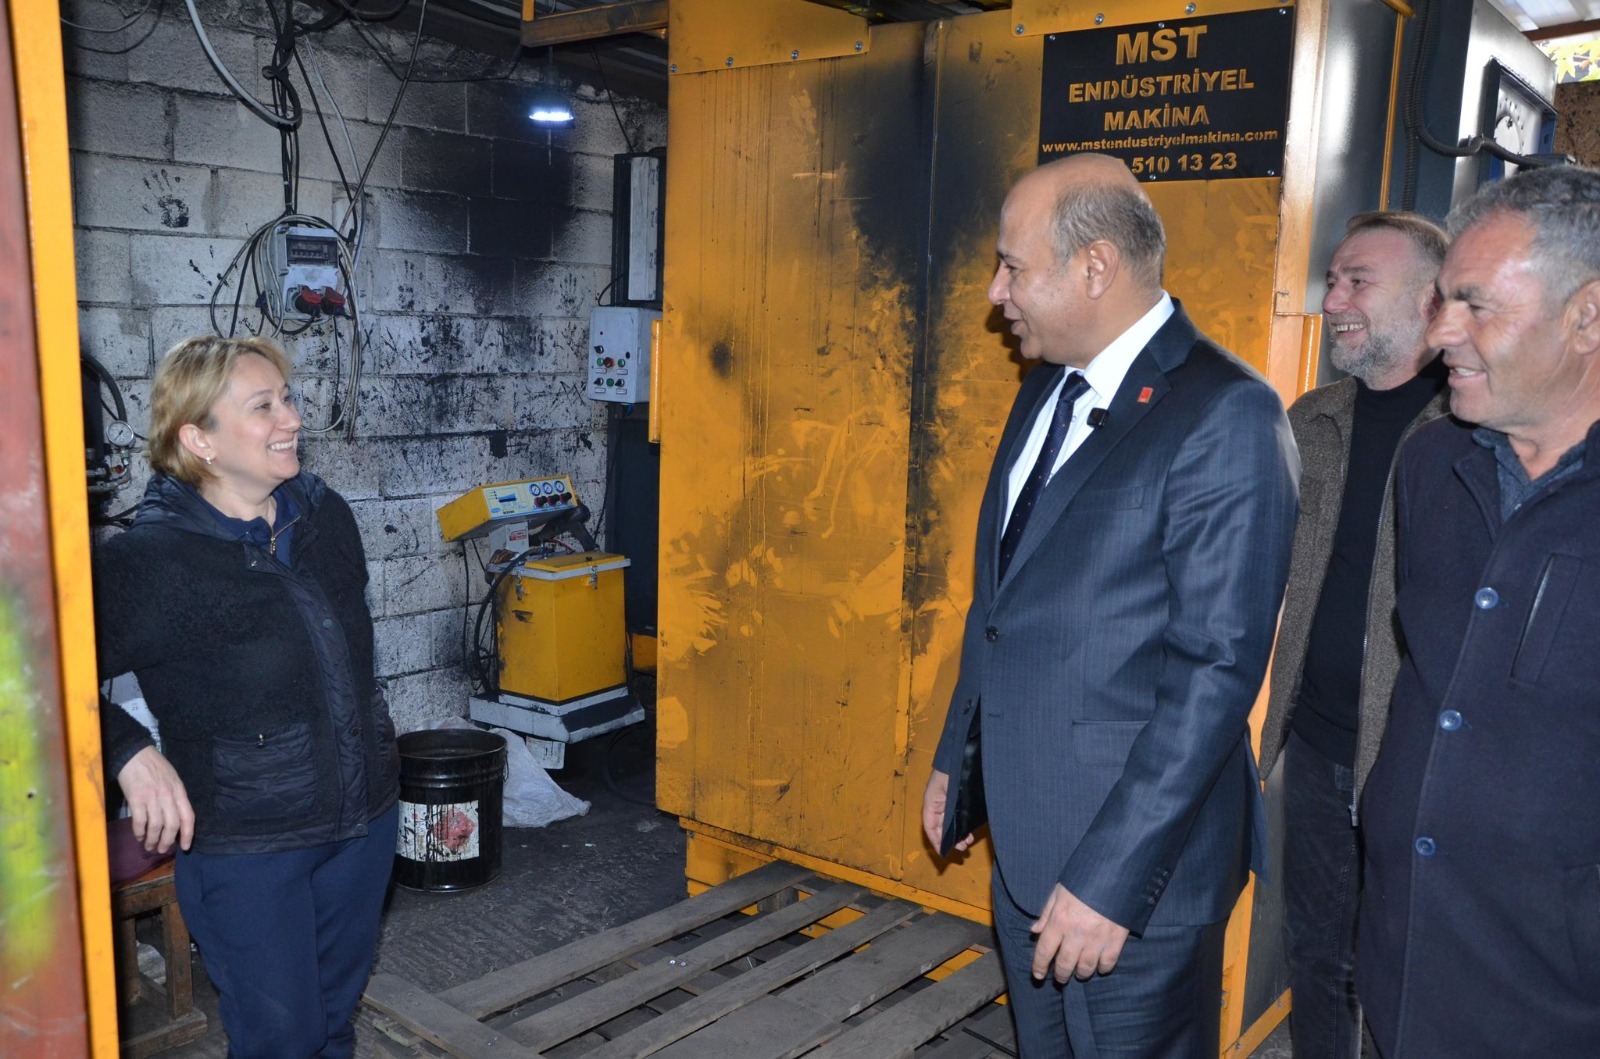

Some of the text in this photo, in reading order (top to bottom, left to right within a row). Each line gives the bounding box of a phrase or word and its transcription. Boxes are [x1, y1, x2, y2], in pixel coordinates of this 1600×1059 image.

[1116, 25, 1207, 65] MST
[1069, 68, 1254, 102] ENDÜSTRİYEL
[1104, 103, 1210, 131] MAKİNA
[1042, 130, 1278, 152] www.mstendustriyelmakina.com
[1131, 152, 1238, 174] 510 13 23
